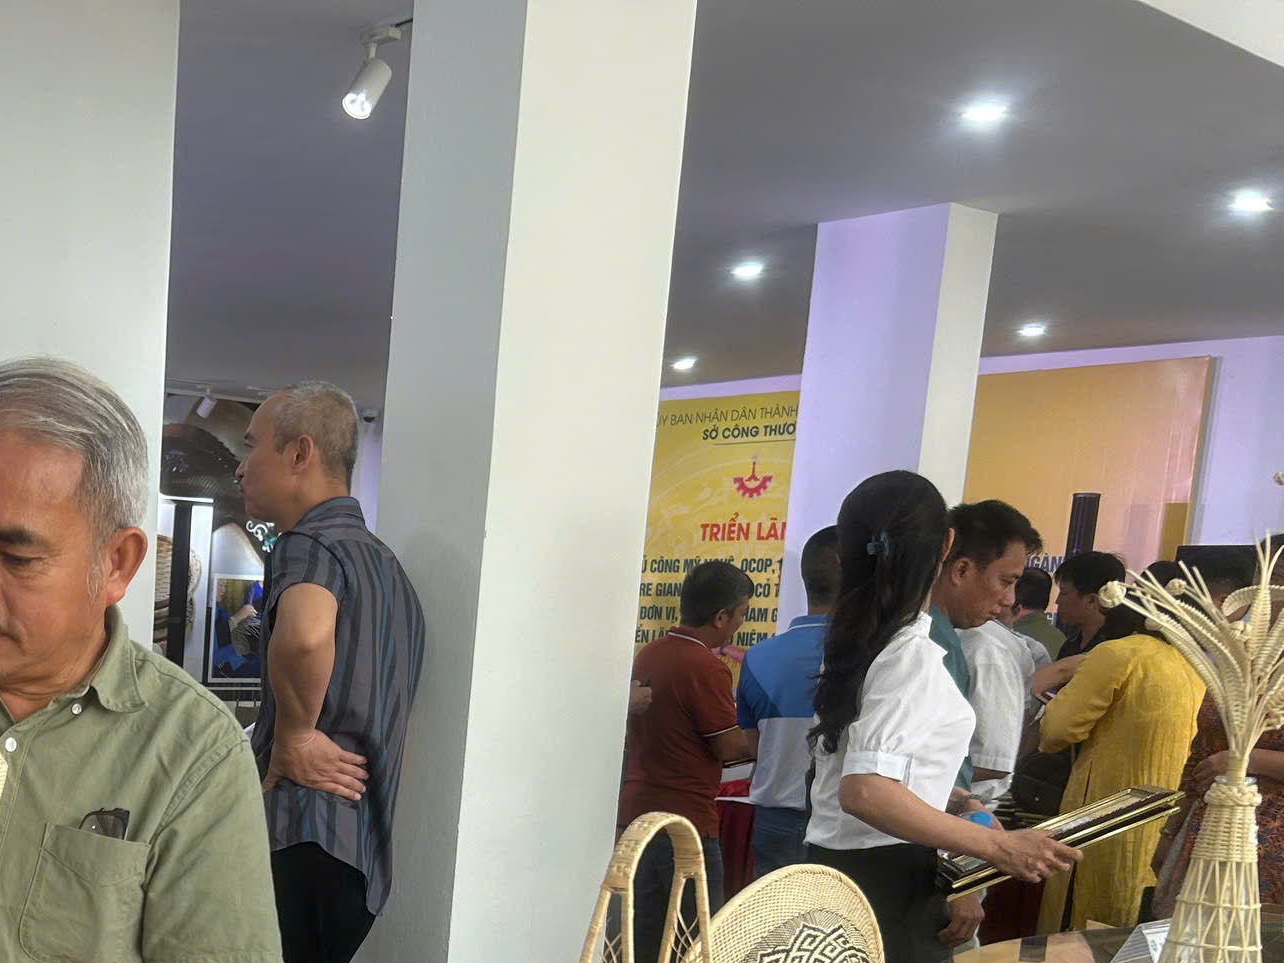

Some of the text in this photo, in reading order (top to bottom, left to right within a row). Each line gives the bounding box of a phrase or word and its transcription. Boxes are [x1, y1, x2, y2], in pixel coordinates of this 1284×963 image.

[670, 413, 693, 426] BAN
[695, 408, 728, 424] NHÂN
[730, 406, 757, 422] DÂN
[759, 403, 798, 419] THÀNH
[702, 425, 719, 440] SỞ
[722, 424, 759, 439] CÔNG
[700, 511, 750, 541] TRIỂN
[650, 556, 680, 573] CÔNG
[741, 558, 775, 574] OCOP,
[640, 605, 662, 620] ĐƠN
[666, 606, 678, 622] VỊ,
